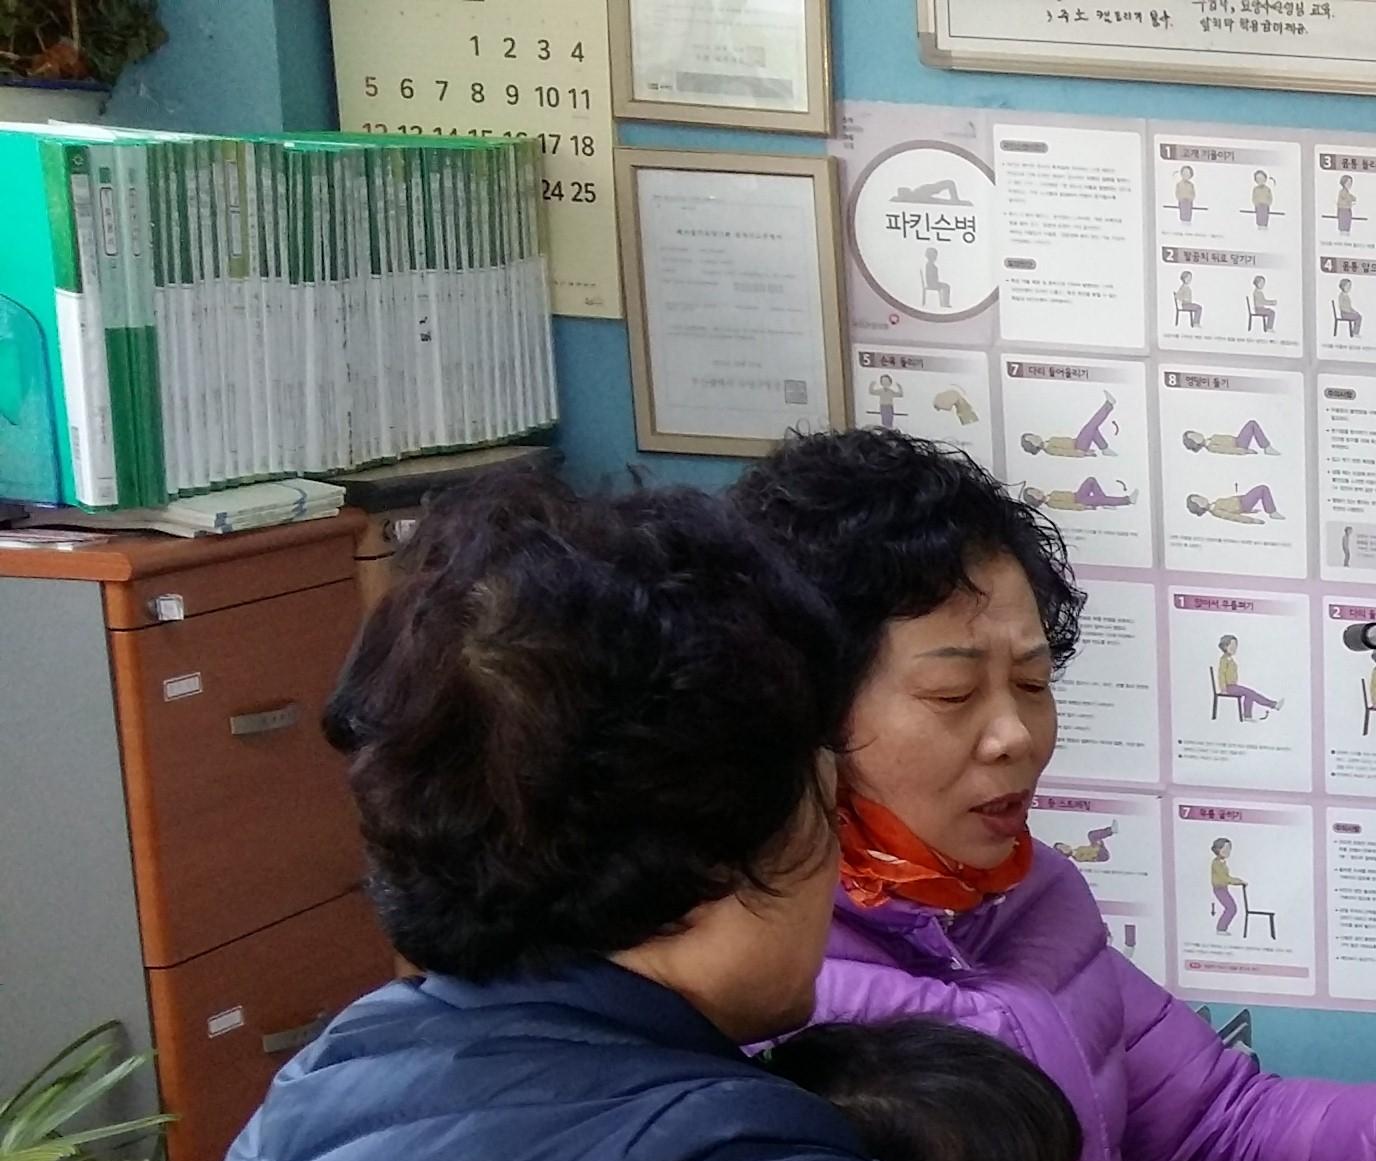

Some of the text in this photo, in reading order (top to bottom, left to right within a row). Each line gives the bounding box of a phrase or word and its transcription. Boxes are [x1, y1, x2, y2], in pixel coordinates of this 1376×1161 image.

[470, 35, 585, 63] 1 2 3 4
[365, 76, 590, 110] 5 6 7 8 9 10 11
[537, 133, 594, 156] 17 18
[1163, 146, 1172, 158] 1
[1323, 157, 1332, 168] 3
[541, 178, 596, 203] 24 25
[885, 211, 976, 243] 파킨슨병
[1166, 249, 1175, 261] 2
[1323, 259, 1333, 271] 4
[862, 354, 871, 365] 5
[1010, 364, 1020, 375] 7
[1168, 374, 1177, 385] 8
[1177, 597, 1184, 608] 1
[1332, 607, 1341, 617] 2
[1183, 807, 1191, 817] 7
